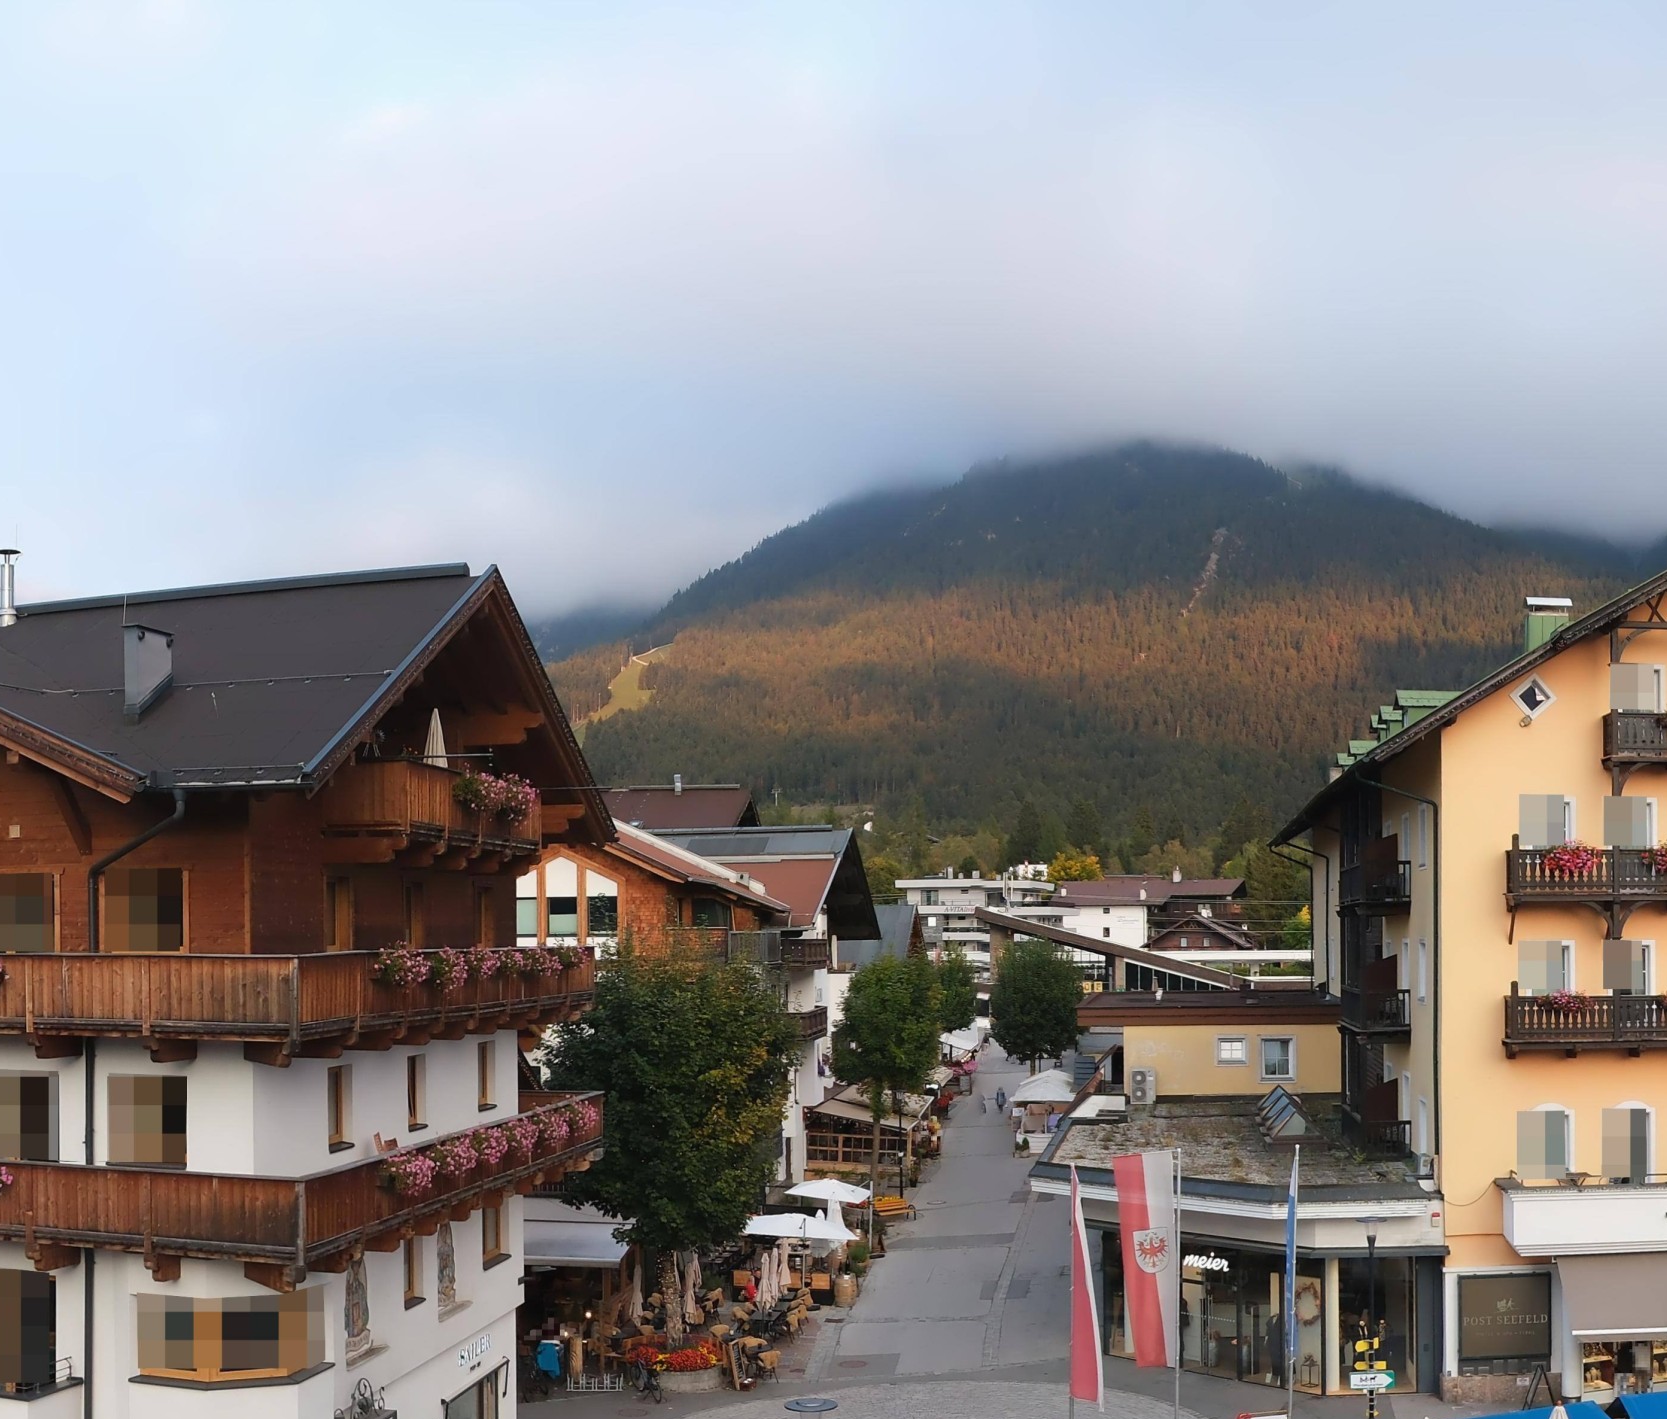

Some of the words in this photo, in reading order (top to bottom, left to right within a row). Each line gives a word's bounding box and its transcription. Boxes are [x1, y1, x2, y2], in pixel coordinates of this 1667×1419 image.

[1183, 1252, 1230, 1273] meier
[1463, 1316, 1492, 1327] POST
[1496, 1314, 1548, 1326] SEEFELD
